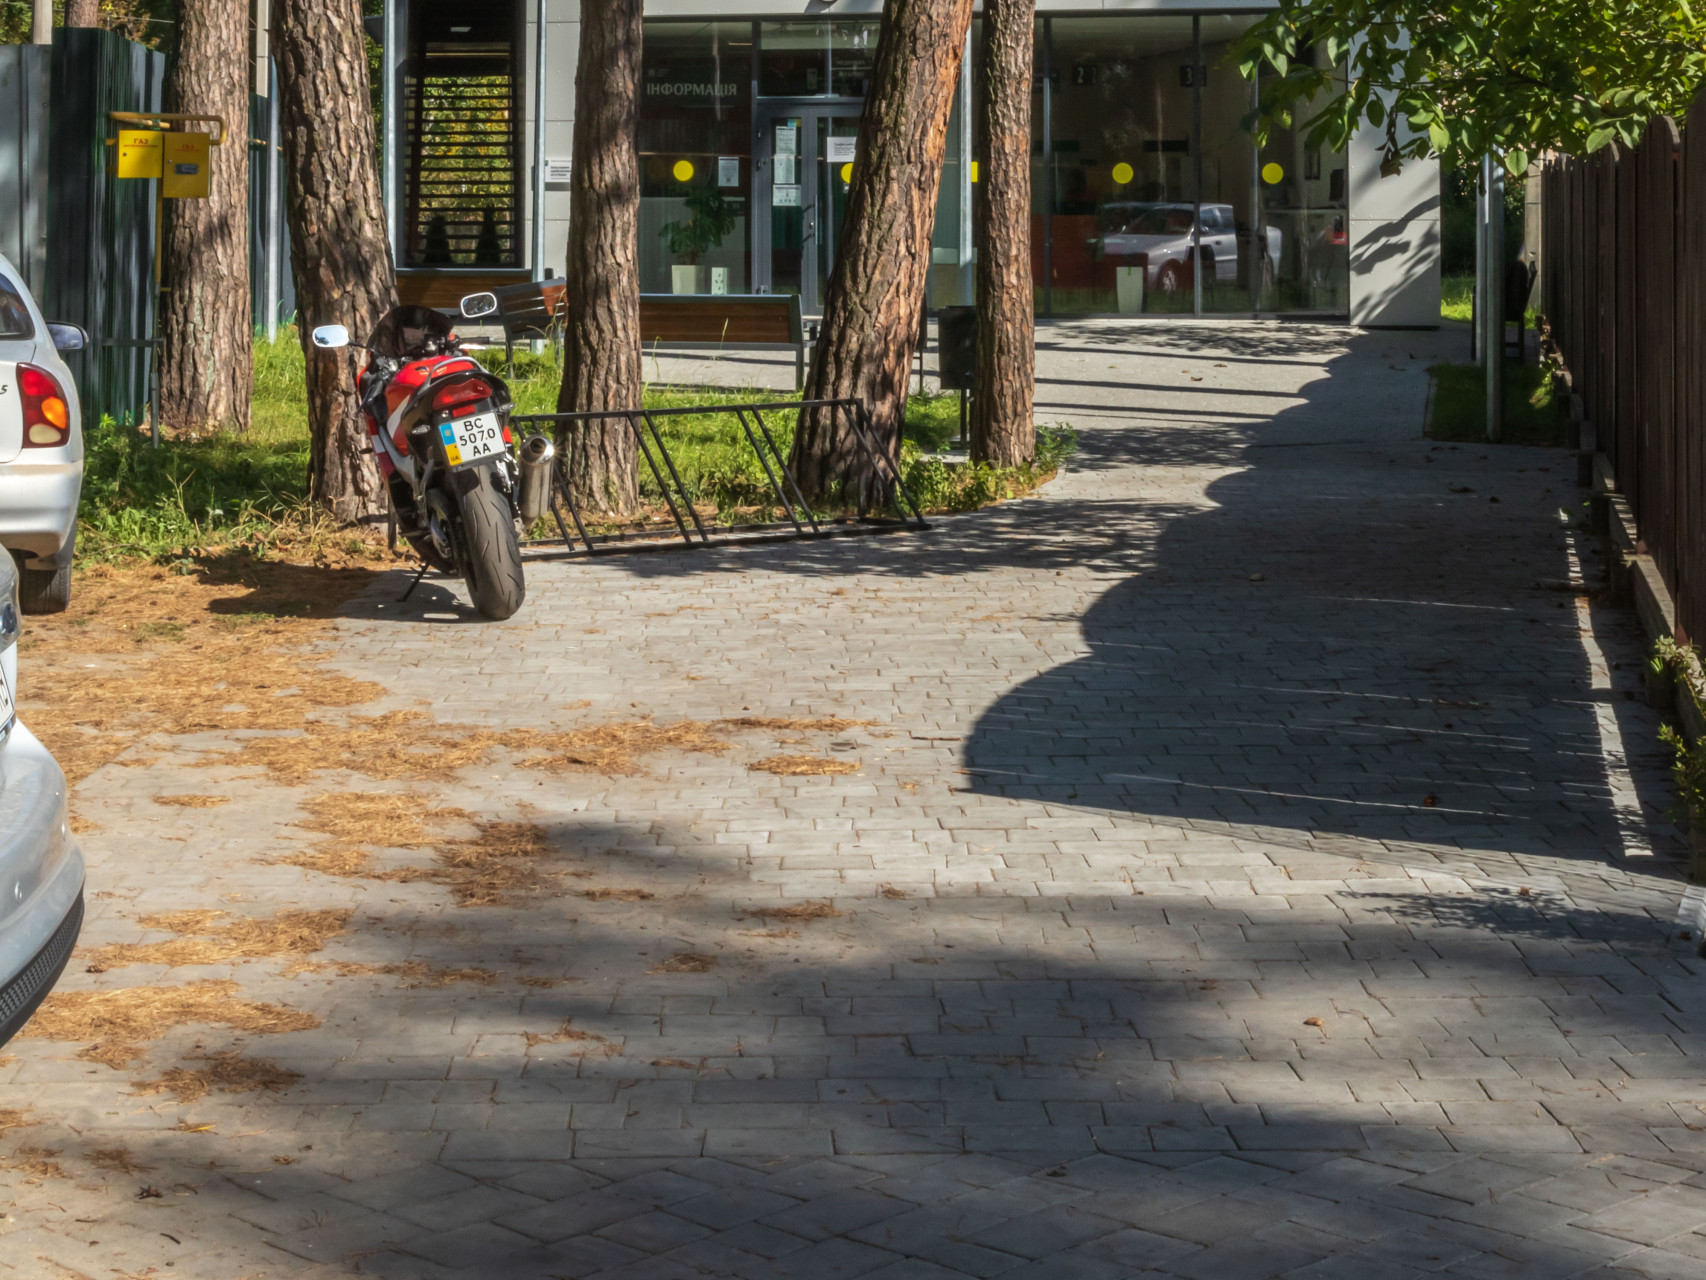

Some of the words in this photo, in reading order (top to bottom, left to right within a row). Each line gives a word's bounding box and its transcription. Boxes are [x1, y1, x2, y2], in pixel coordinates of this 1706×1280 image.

[646, 82, 737, 97] ІНФОРМАЦІЯ
[464, 418, 483, 431] BC
[459, 428, 496, 446] 5070
[473, 443, 491, 457] AA
